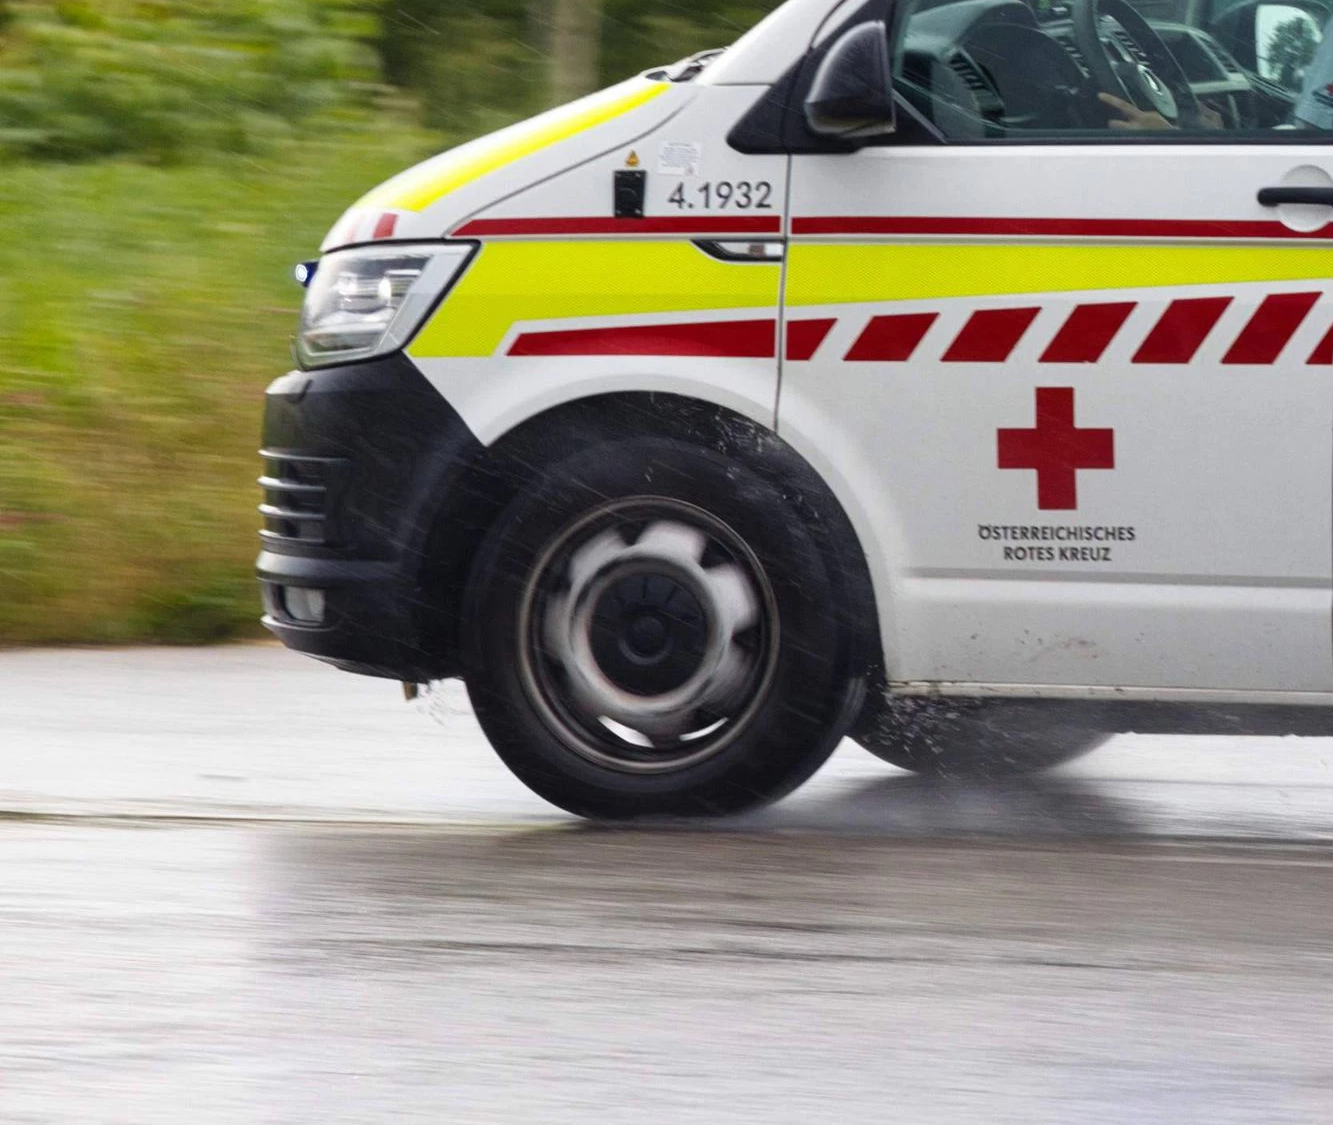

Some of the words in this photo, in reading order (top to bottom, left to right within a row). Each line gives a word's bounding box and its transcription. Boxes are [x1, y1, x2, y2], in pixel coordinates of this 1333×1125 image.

[668, 181, 772, 209] 4.1932
[978, 524, 1136, 541] ÖSTERREICHISCHES
[1003, 547, 1054, 561] ROTES
[1059, 547, 1112, 562] KREUZ
